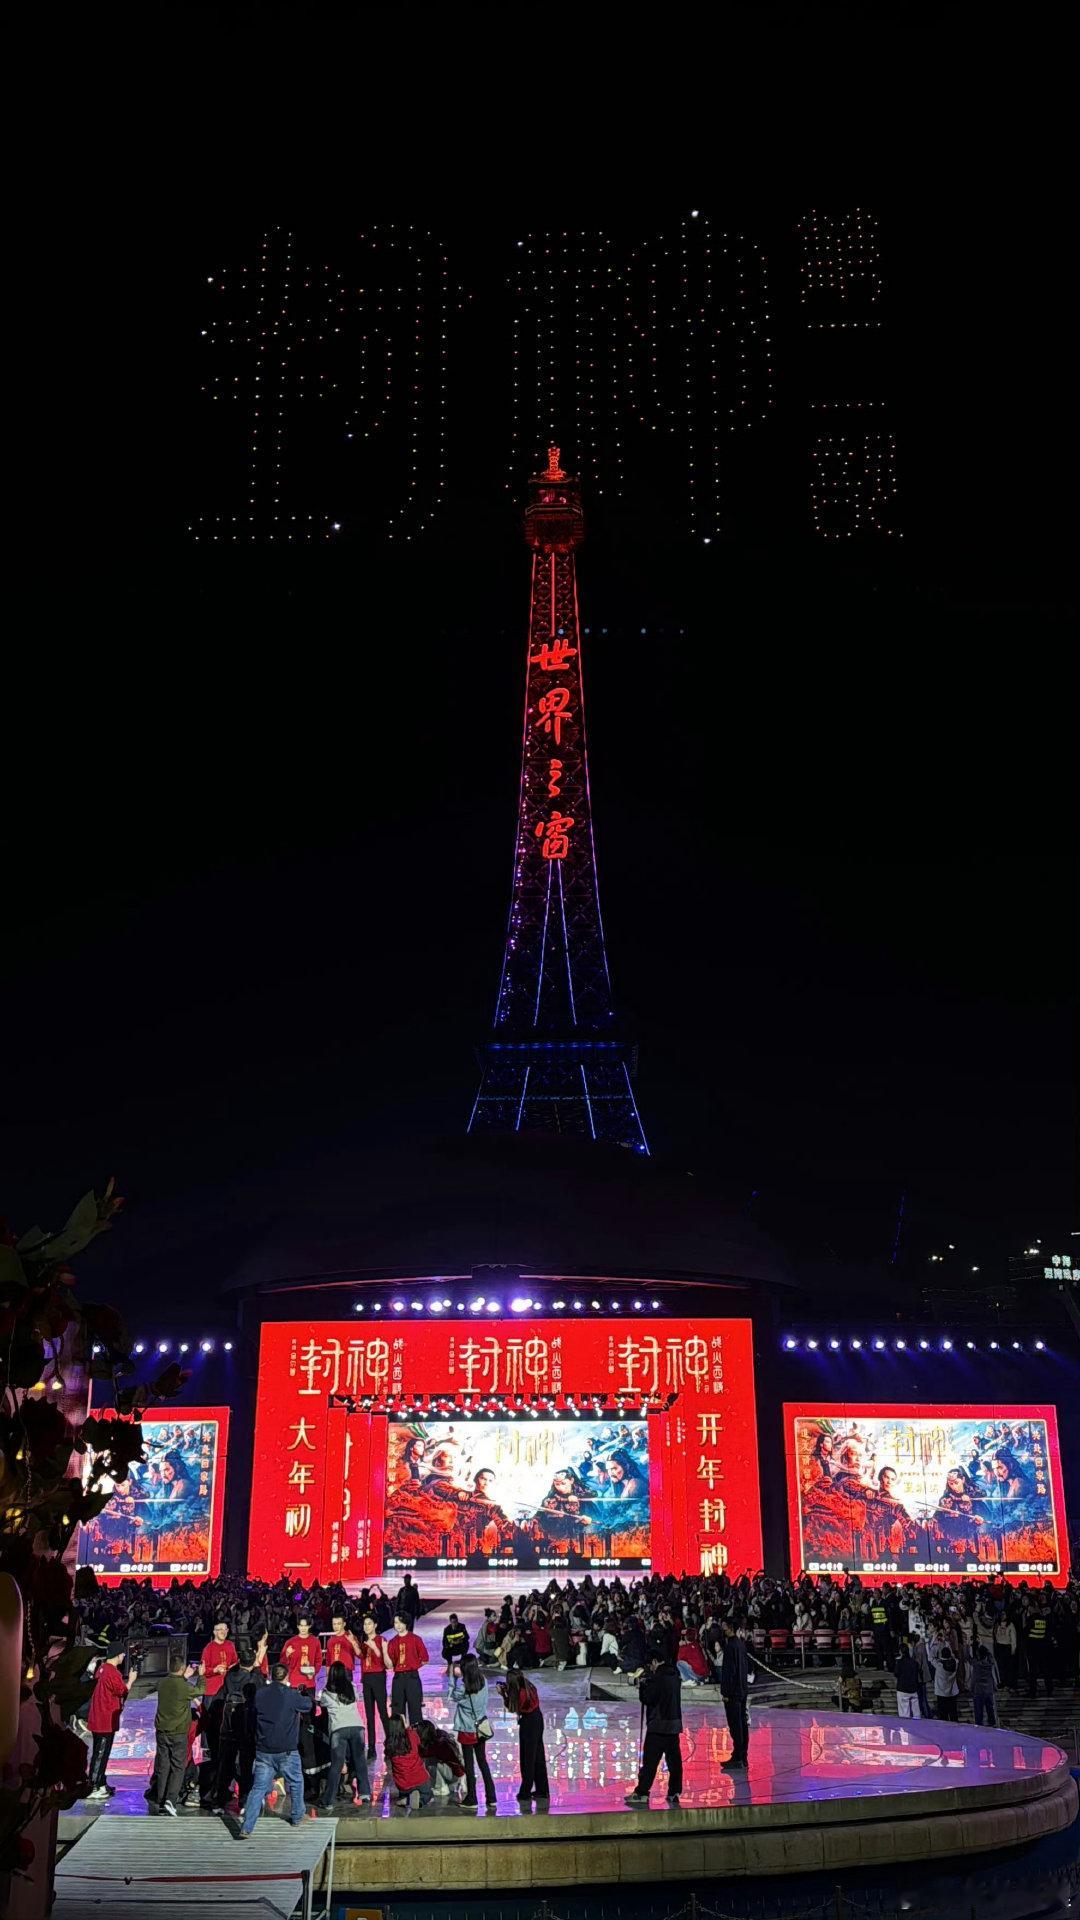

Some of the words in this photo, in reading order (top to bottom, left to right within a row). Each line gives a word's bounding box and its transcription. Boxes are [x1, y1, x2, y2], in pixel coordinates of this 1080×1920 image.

[531, 639, 577, 859] 世界之窗
[298, 1337, 390, 1395] 封神
[458, 1336, 548, 1394] 封神
[618, 1335, 708, 1394] 封神
[284, 1416, 316, 1568] 大年初一
[696, 1413, 728, 1577] 开年封神
